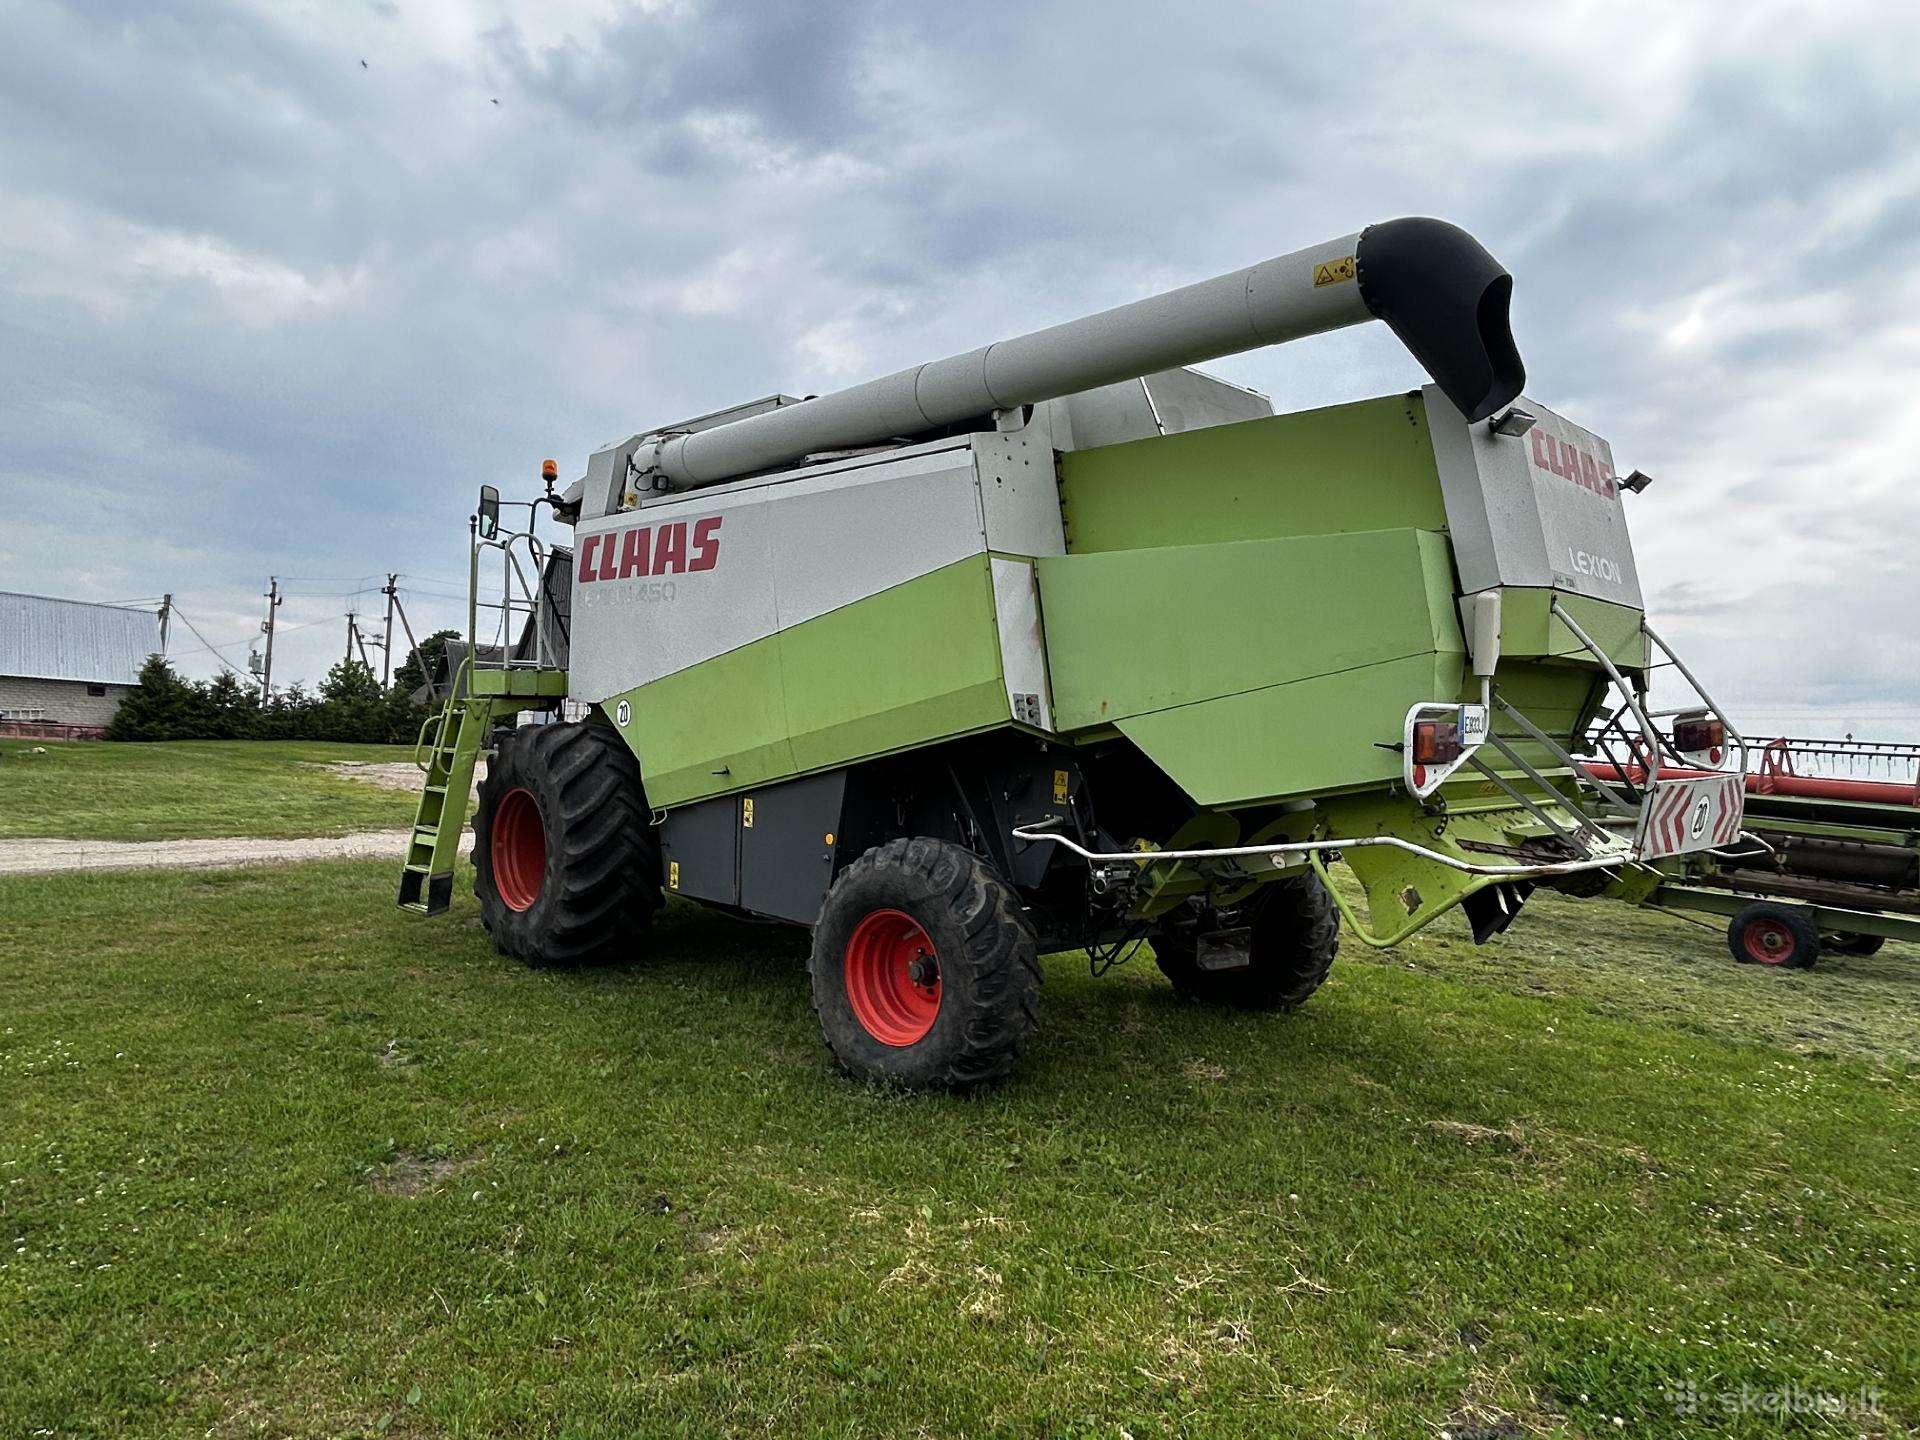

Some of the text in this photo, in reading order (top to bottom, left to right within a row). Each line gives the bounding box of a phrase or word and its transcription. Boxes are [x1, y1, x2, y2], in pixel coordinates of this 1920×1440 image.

[1530, 427, 1616, 500] CLAAS
[578, 516, 723, 583] CLAAS
[1568, 546, 1622, 585] LEXION
[1692, 803, 1708, 833] 20
